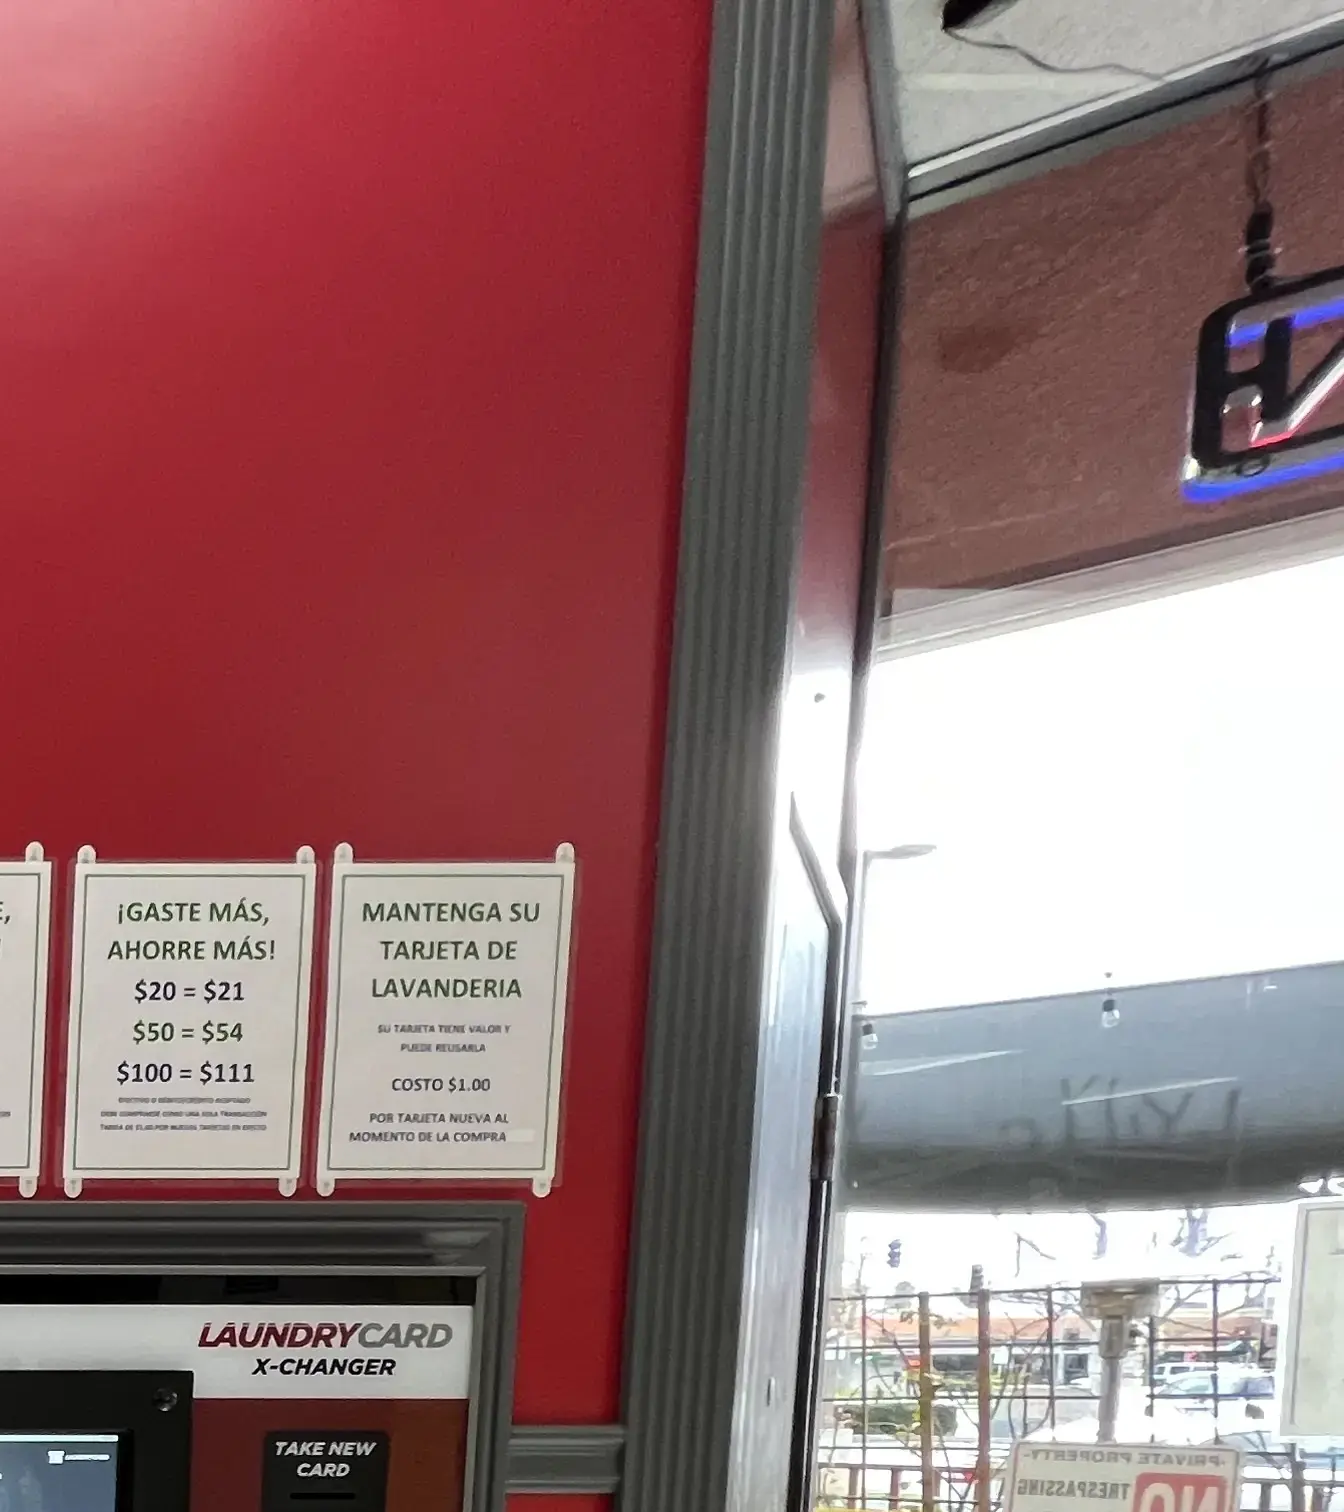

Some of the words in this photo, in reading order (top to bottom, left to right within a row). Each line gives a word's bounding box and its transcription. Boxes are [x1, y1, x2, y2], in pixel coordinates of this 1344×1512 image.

[118, 902, 201, 924] ¡GASTE
[209, 897, 268, 926] MÁS,
[363, 902, 502, 922] MANTENGA
[510, 903, 540, 922] SU
[108, 940, 206, 960] AHORRE
[214, 936, 274, 960] MÁS!
[380, 941, 480, 960] TARJETA
[488, 941, 517, 960] DE
[372, 978, 521, 998] LAVANDERIA
[392, 1078, 443, 1091] COSTO
[448, 1076, 490, 1093] $1.00
[370, 1113, 394, 1123] POR
[398, 1113, 446, 1123] TARJETA
[450, 1113, 491, 1124] NUEVA
[494, 1113, 509, 1124] AL
[349, 1131, 415, 1142] MOMENTO
[418, 1132, 432, 1142] DE
[436, 1132, 450, 1142] LA
[454, 1132, 506, 1142] COMPRA
[198, 1322, 452, 1348] LAUNDRYCARD
[252, 1358, 396, 1375] X-CHANGER
[276, 1442, 326, 1456] TAKE
[328, 1442, 376, 1455] NEW
[297, 1463, 350, 1477] CARD
